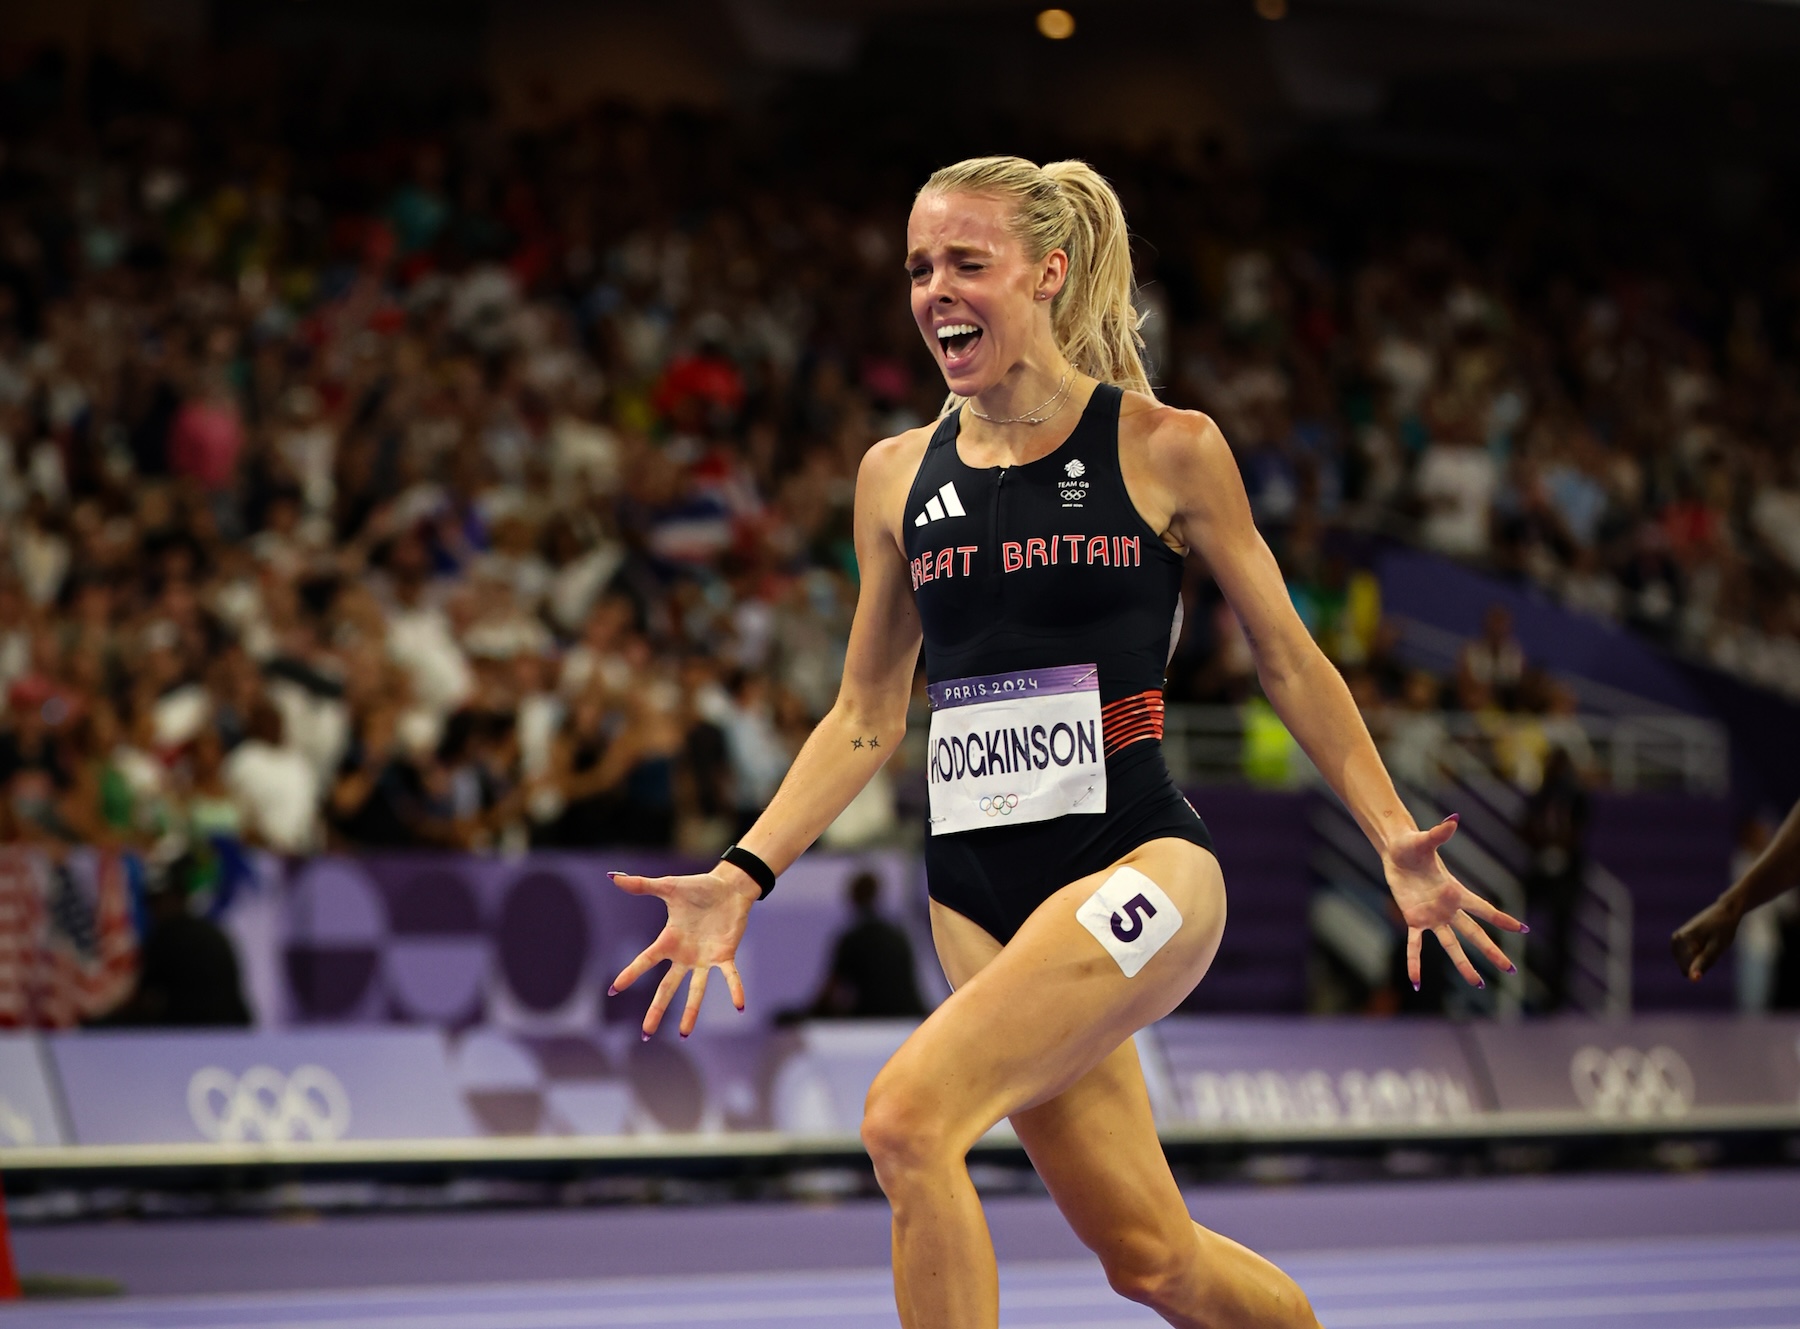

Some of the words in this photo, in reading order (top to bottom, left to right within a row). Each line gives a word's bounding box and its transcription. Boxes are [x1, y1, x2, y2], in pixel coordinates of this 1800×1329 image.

[1058, 480, 1078, 489] TEAM
[1002, 534, 1140, 573] BRITAIN
[992, 677, 1038, 694] 2024
[930, 719, 1097, 784] HODGKINSON
[1110, 892, 1157, 943] 5
